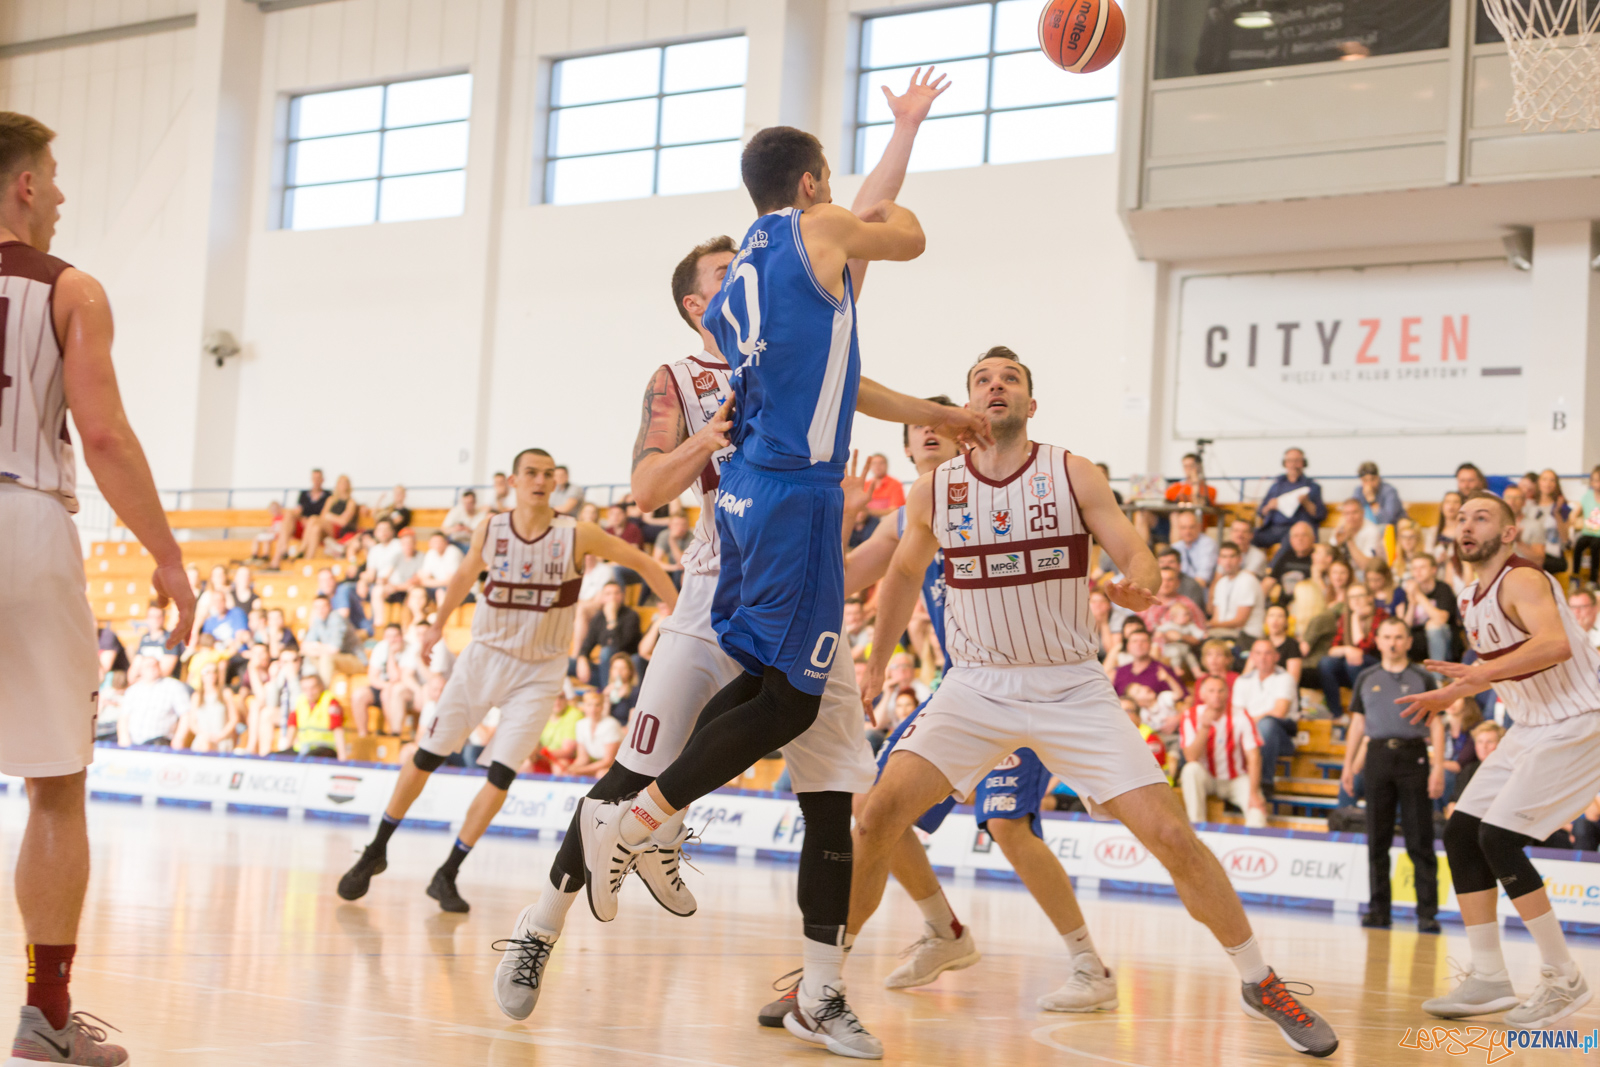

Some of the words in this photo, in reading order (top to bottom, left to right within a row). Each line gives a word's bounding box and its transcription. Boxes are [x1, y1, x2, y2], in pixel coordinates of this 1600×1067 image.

[1067, 0, 1092, 50] molten
[1204, 315, 1470, 369] CITYZEN
[1552, 412, 1567, 431] B
[1029, 502, 1058, 532] 25
[545, 562, 563, 580] 44
[991, 561, 1019, 571] MPGK
[1037, 556, 1060, 568] ZZO
[810, 630, 839, 668] 0
[630, 710, 660, 755] 10
[1103, 845, 1138, 861] KIA
[1229, 854, 1267, 875] KIA
[1290, 859, 1347, 880] DELIK
